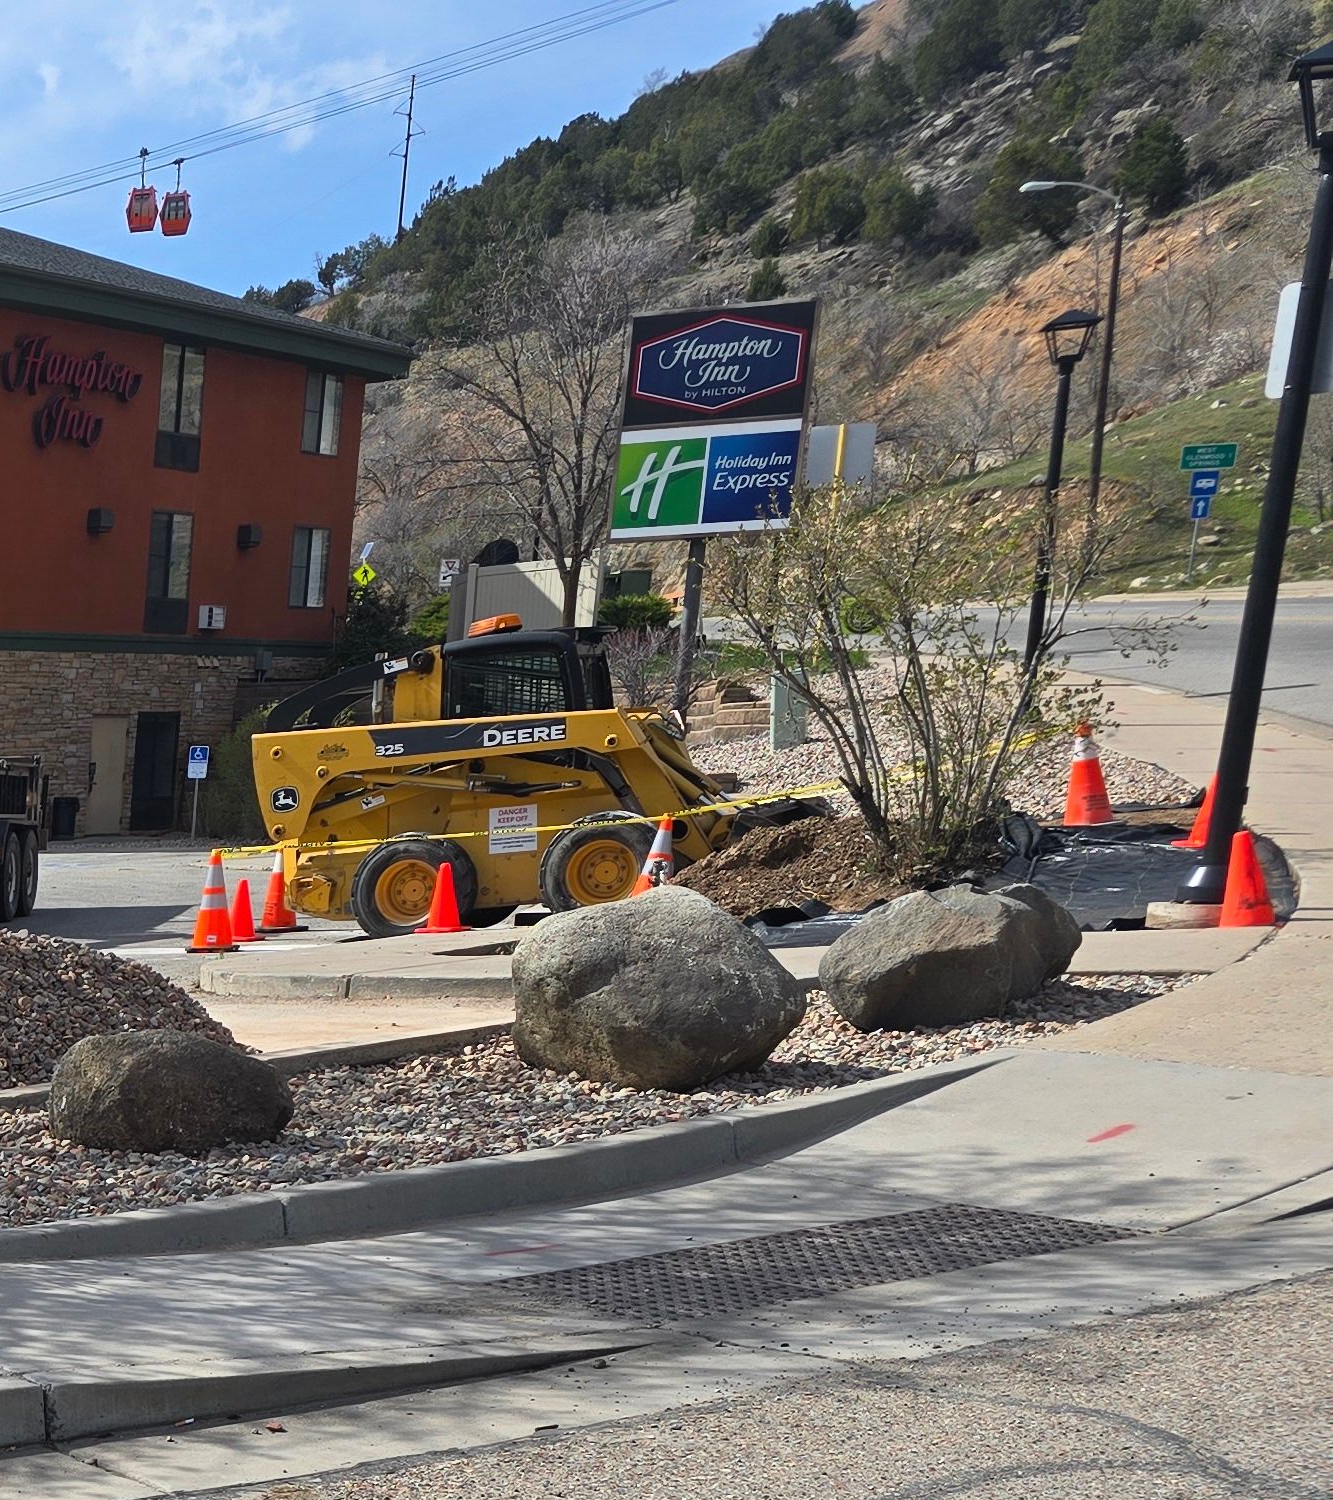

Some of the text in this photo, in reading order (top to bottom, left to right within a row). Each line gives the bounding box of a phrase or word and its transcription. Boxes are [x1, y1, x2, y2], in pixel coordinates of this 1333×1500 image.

[658, 335, 782, 370] Hampton
[0, 336, 143, 402] Hampton
[684, 359, 751, 388] Inn
[684, 385, 747, 400] by HILTON
[33, 394, 103, 448] Inn
[715, 451, 792, 470] Holiday Inn
[712, 471, 791, 494] Express
[483, 724, 566, 747] DEERE
[375, 743, 405, 757] 325
[497, 814, 529, 824] KEEP OFF
[498, 807, 529, 817] DANGER
